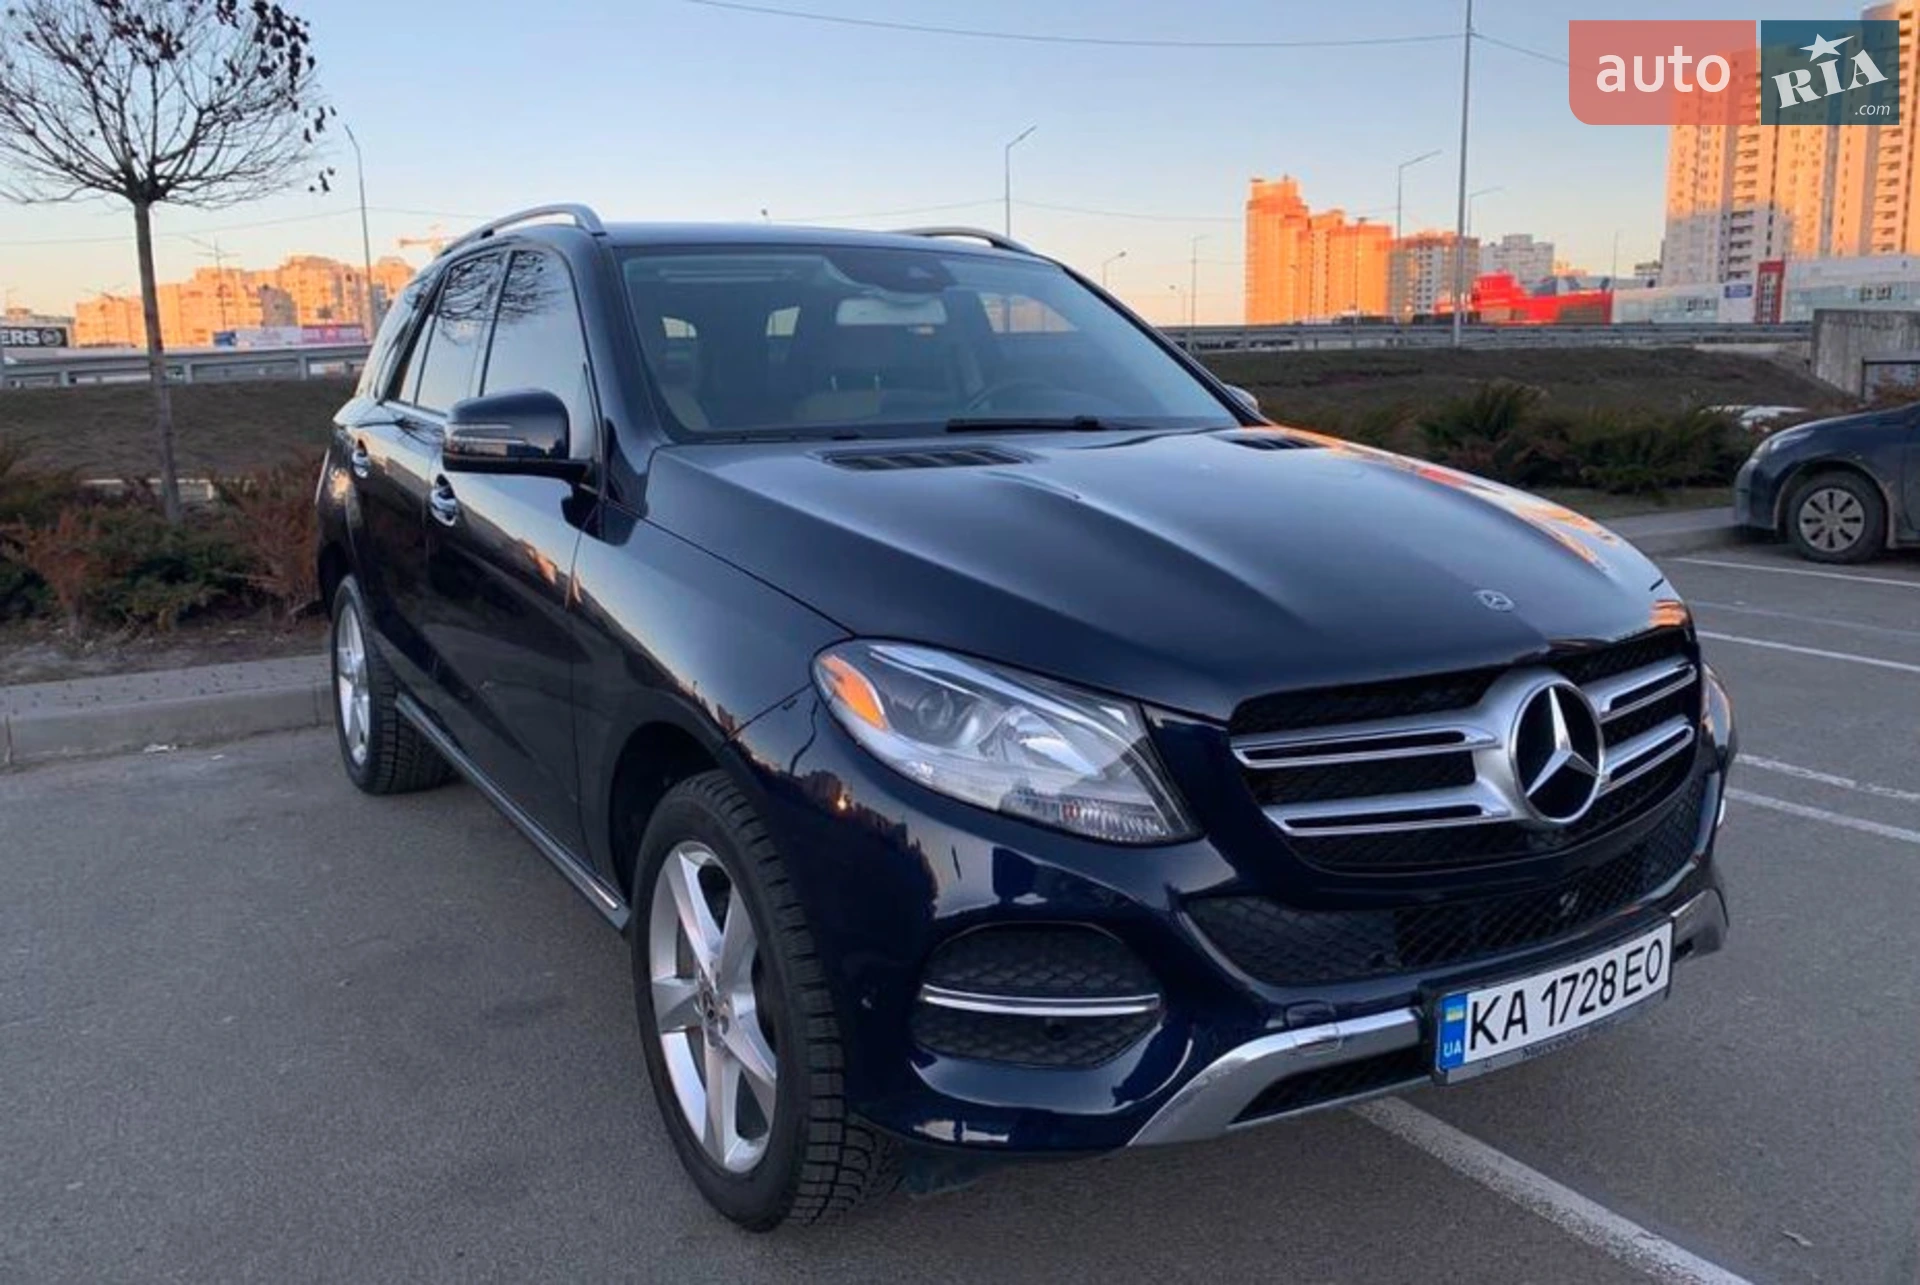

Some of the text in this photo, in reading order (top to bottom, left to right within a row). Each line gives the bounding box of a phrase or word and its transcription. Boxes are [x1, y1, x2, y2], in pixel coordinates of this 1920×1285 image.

[1469, 989, 1528, 1051] KA
[1541, 959, 1618, 1027] 1728
[1623, 938, 1663, 998] EO
[1443, 1039, 1462, 1058] UA
